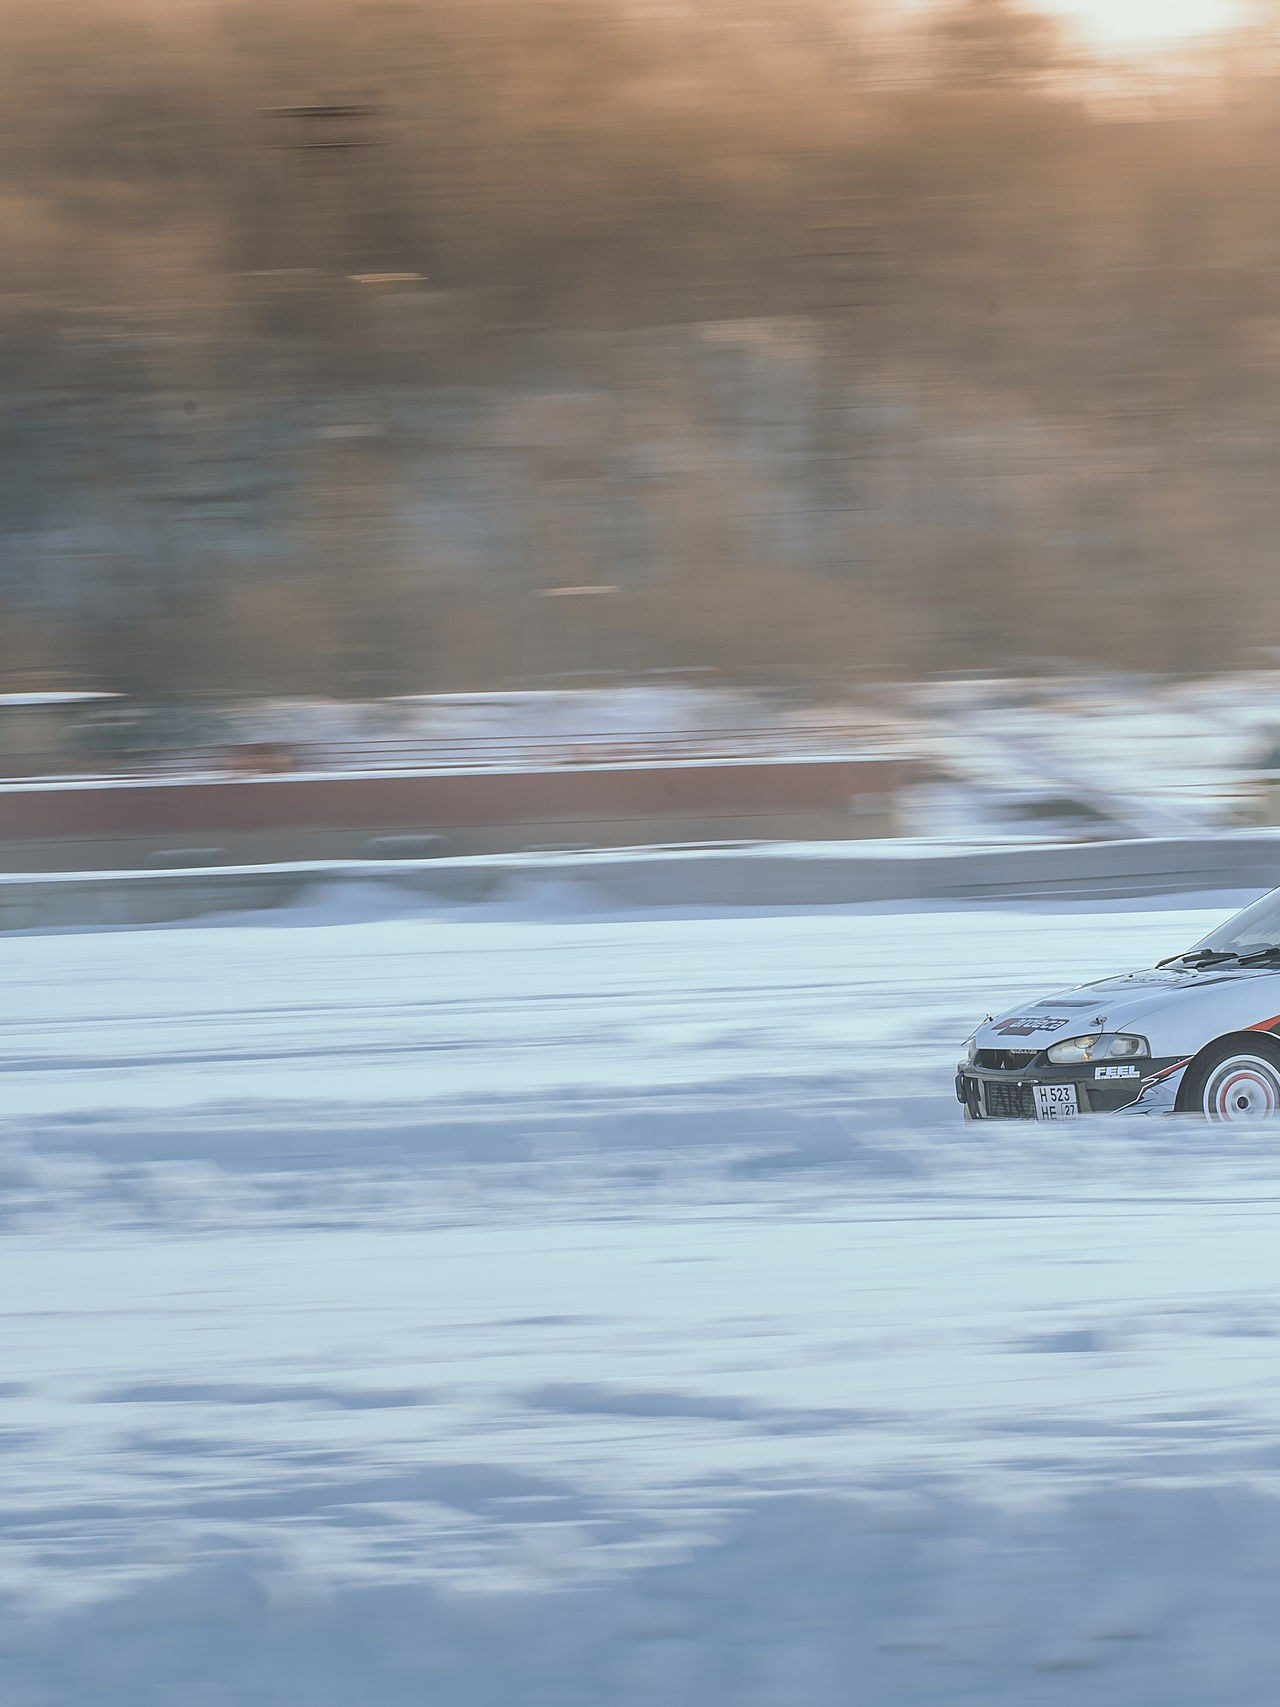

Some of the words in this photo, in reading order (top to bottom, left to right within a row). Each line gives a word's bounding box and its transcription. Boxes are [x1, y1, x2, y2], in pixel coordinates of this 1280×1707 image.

[1095, 1065, 1140, 1079] FEEL
[1050, 1087, 1070, 1102] 523
[1064, 1104, 1075, 1116] 27
